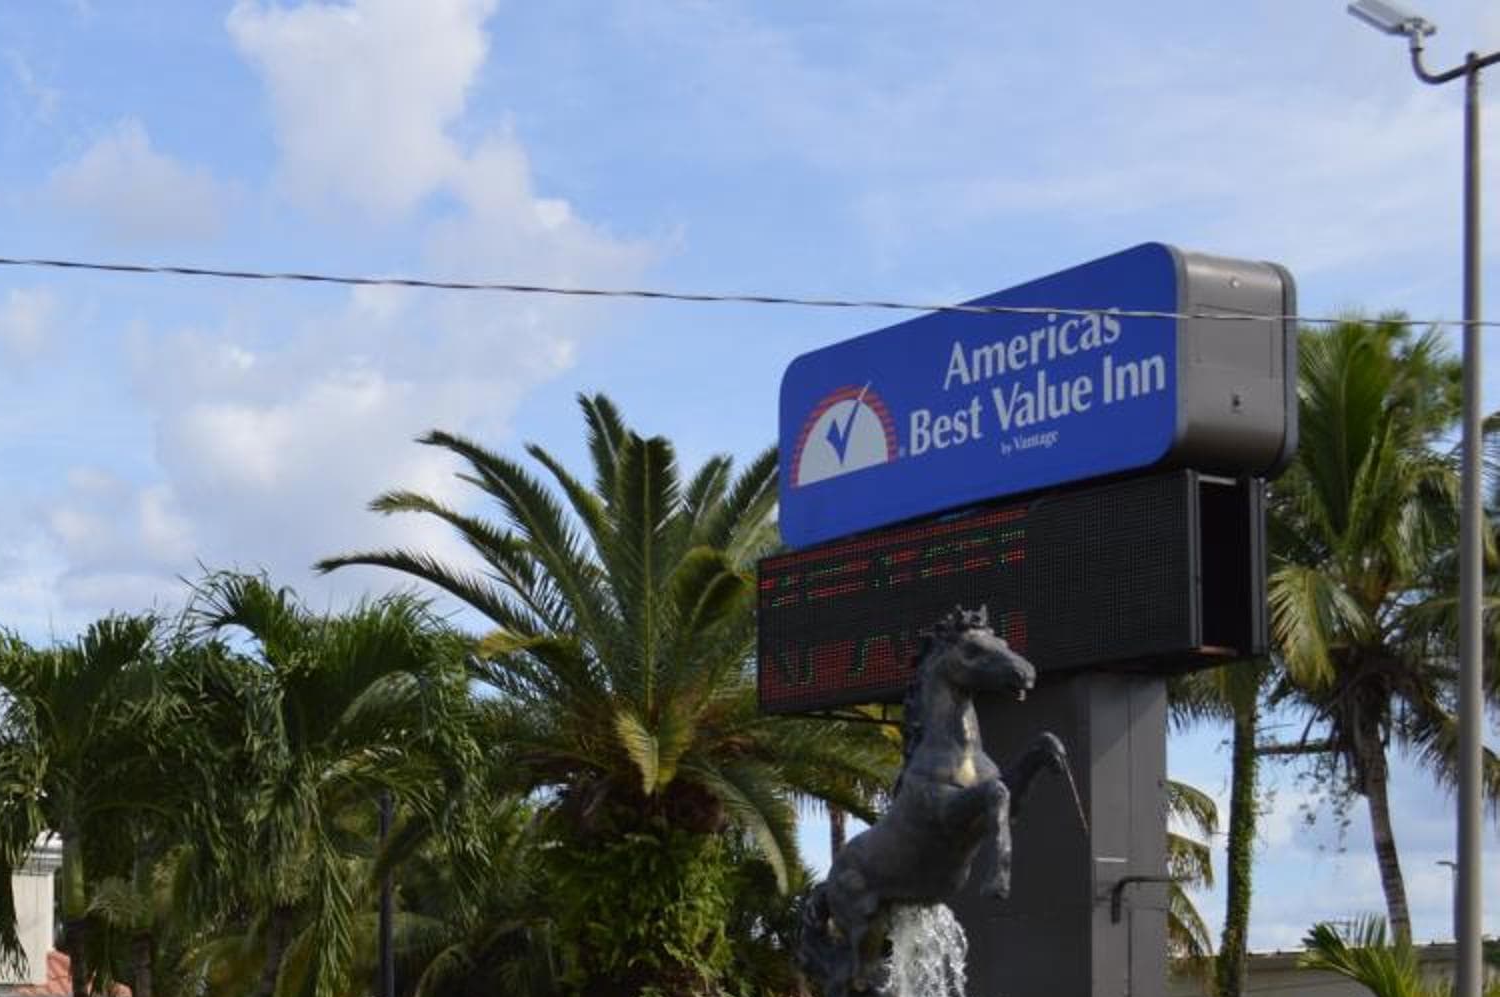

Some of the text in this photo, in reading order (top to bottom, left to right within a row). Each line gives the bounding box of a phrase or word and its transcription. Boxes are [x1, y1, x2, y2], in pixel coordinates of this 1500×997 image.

[943, 307, 1122, 391] Americas
[909, 354, 1166, 456] Best Value Inn
[1012, 429, 1060, 451] Vantage
